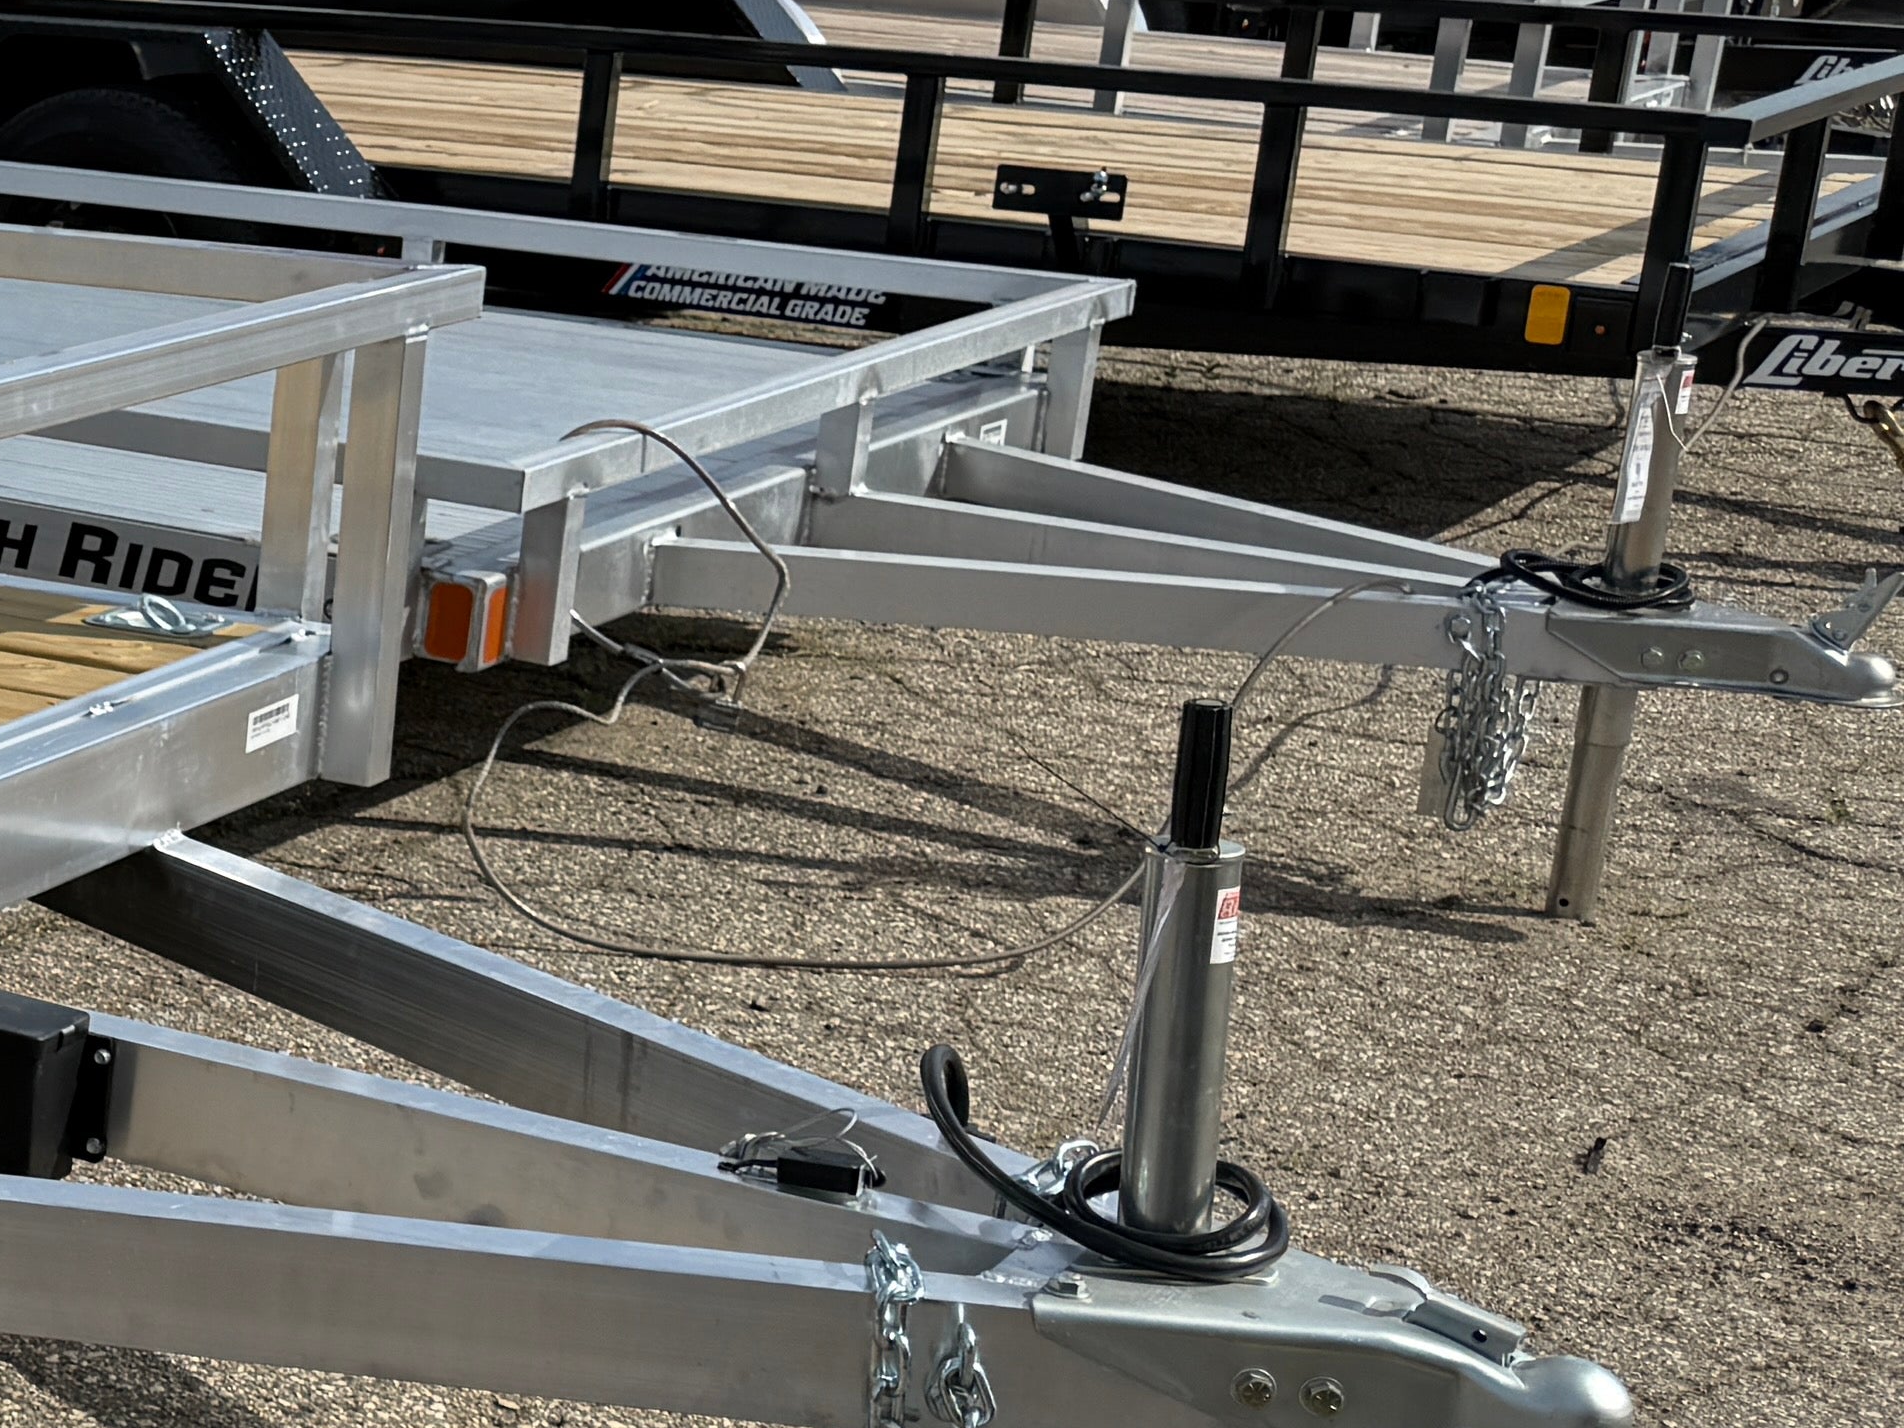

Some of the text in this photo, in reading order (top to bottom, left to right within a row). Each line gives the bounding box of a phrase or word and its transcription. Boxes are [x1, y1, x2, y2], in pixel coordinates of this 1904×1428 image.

[627, 279, 871, 327] COMMERCIAL GRADE
[1742, 333, 1904, 387] Liber
[58, 521, 258, 612] RIDE
